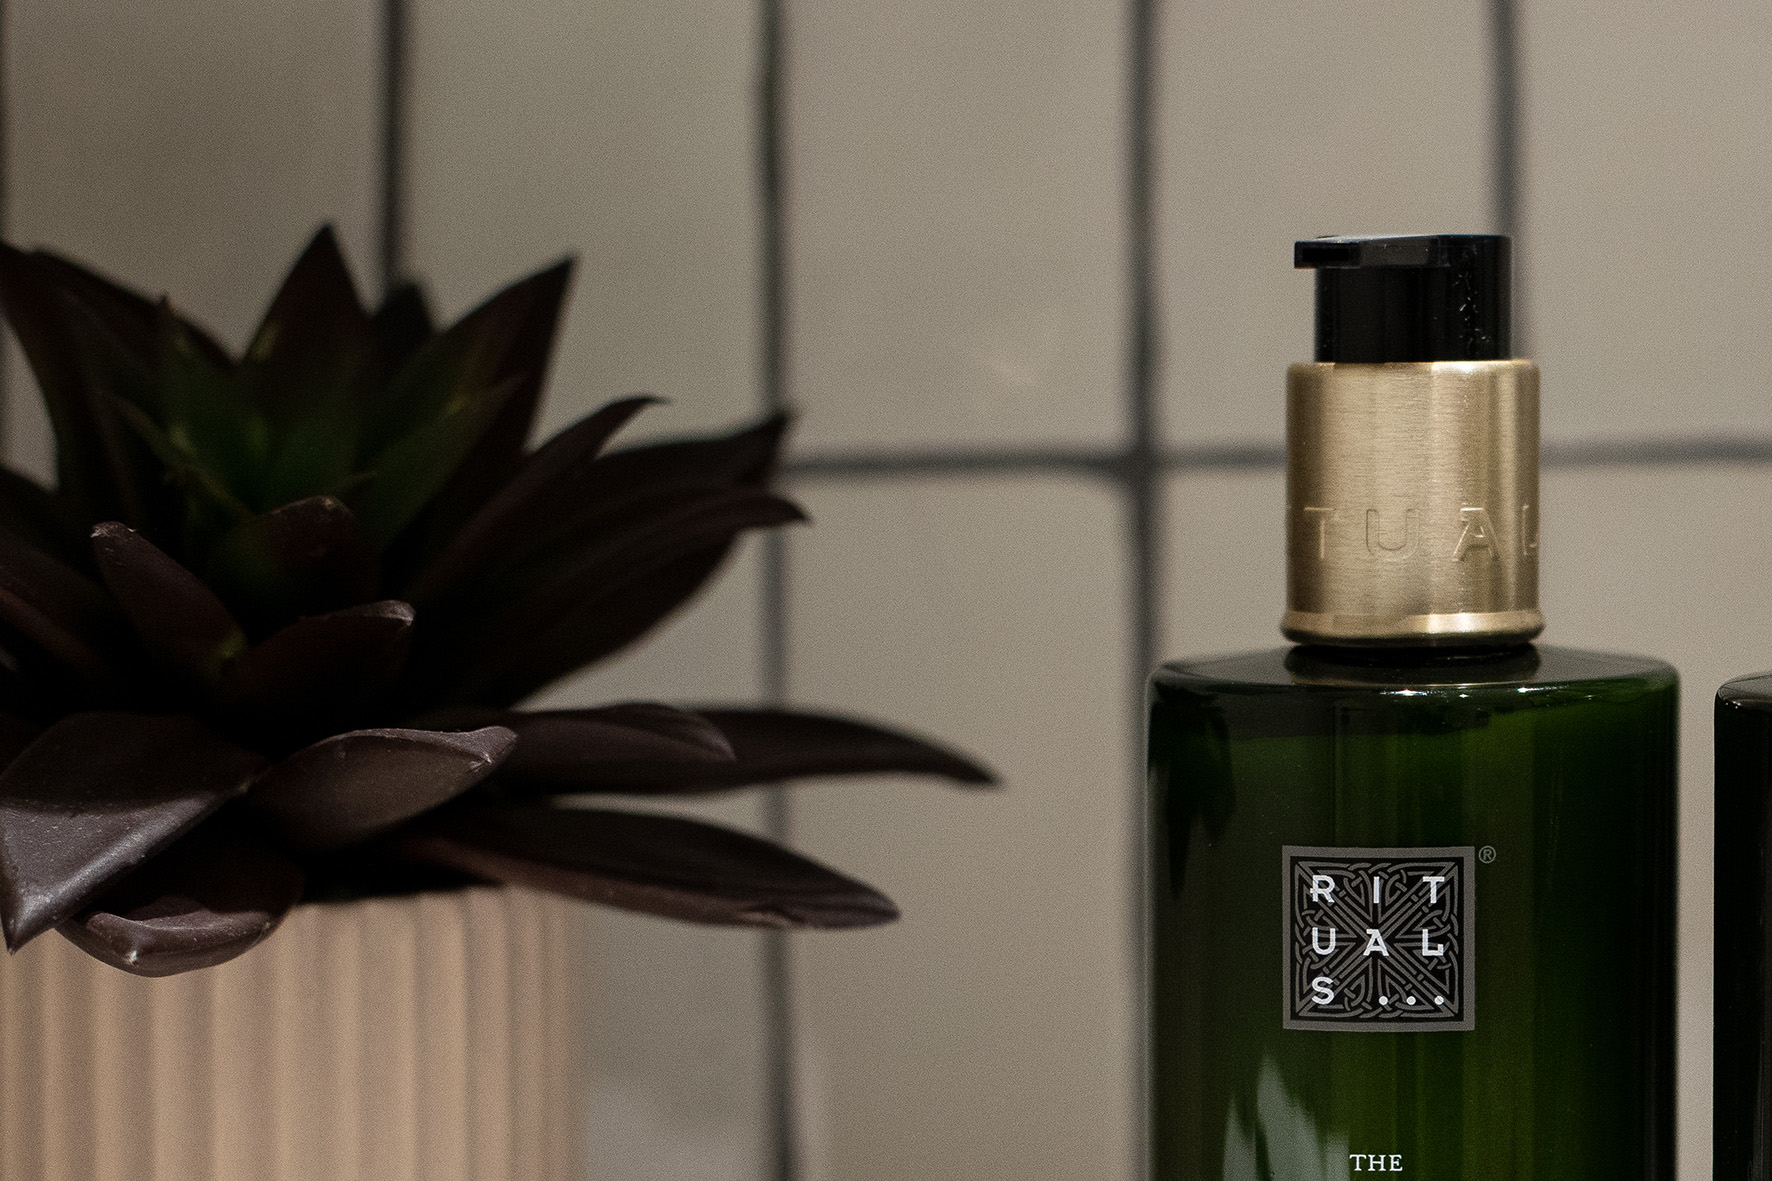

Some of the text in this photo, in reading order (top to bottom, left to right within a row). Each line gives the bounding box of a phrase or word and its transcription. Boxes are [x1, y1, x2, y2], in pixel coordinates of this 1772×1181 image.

[1310, 874, 1445, 904] RIT
[1311, 927, 1445, 957] UAL
[1349, 1153, 1404, 1172] THE
